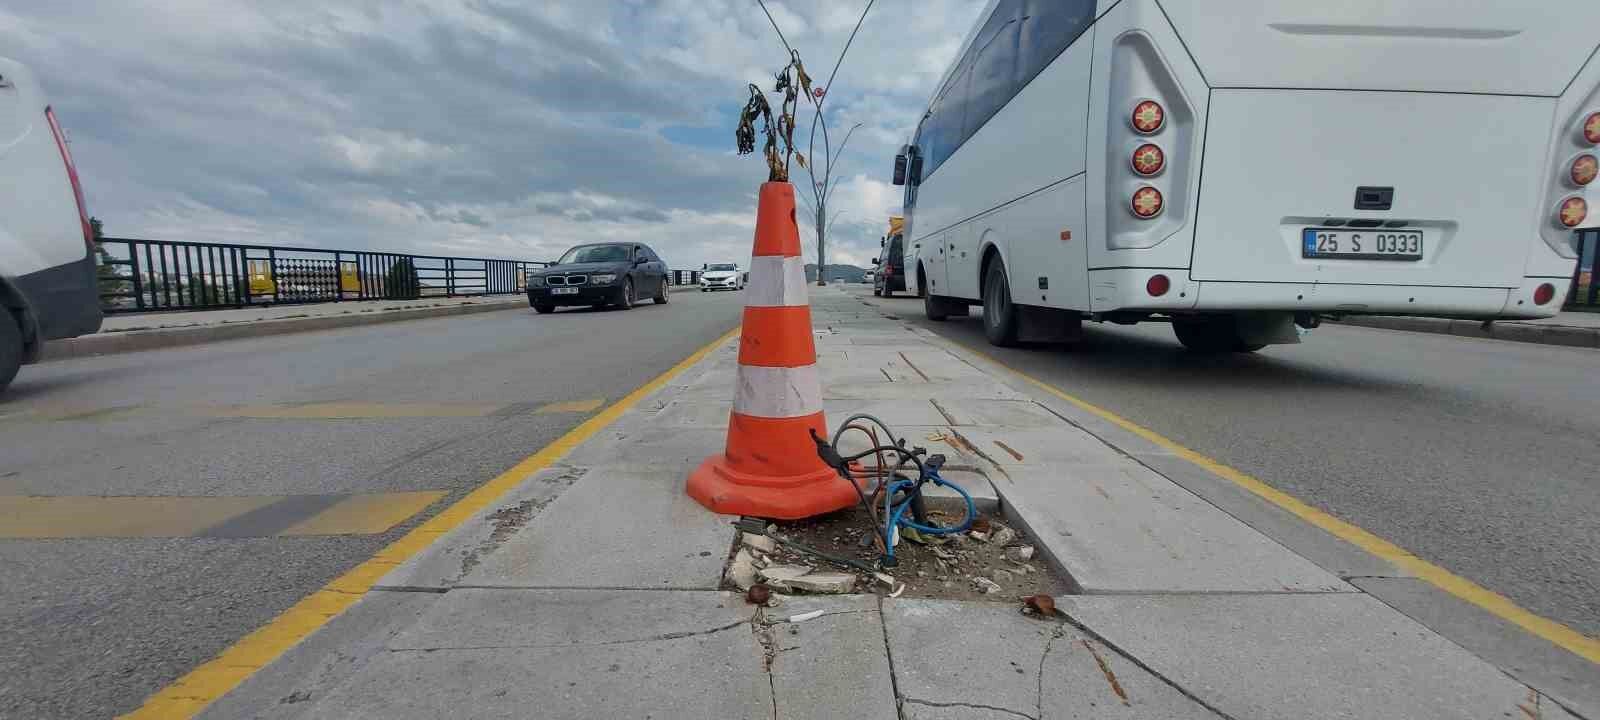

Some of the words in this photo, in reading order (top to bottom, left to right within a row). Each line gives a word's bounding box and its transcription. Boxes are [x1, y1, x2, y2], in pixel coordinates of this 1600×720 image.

[1317, 233, 1338, 252] 25
[1351, 233, 1361, 252] S
[1376, 234, 1418, 253] 0333
